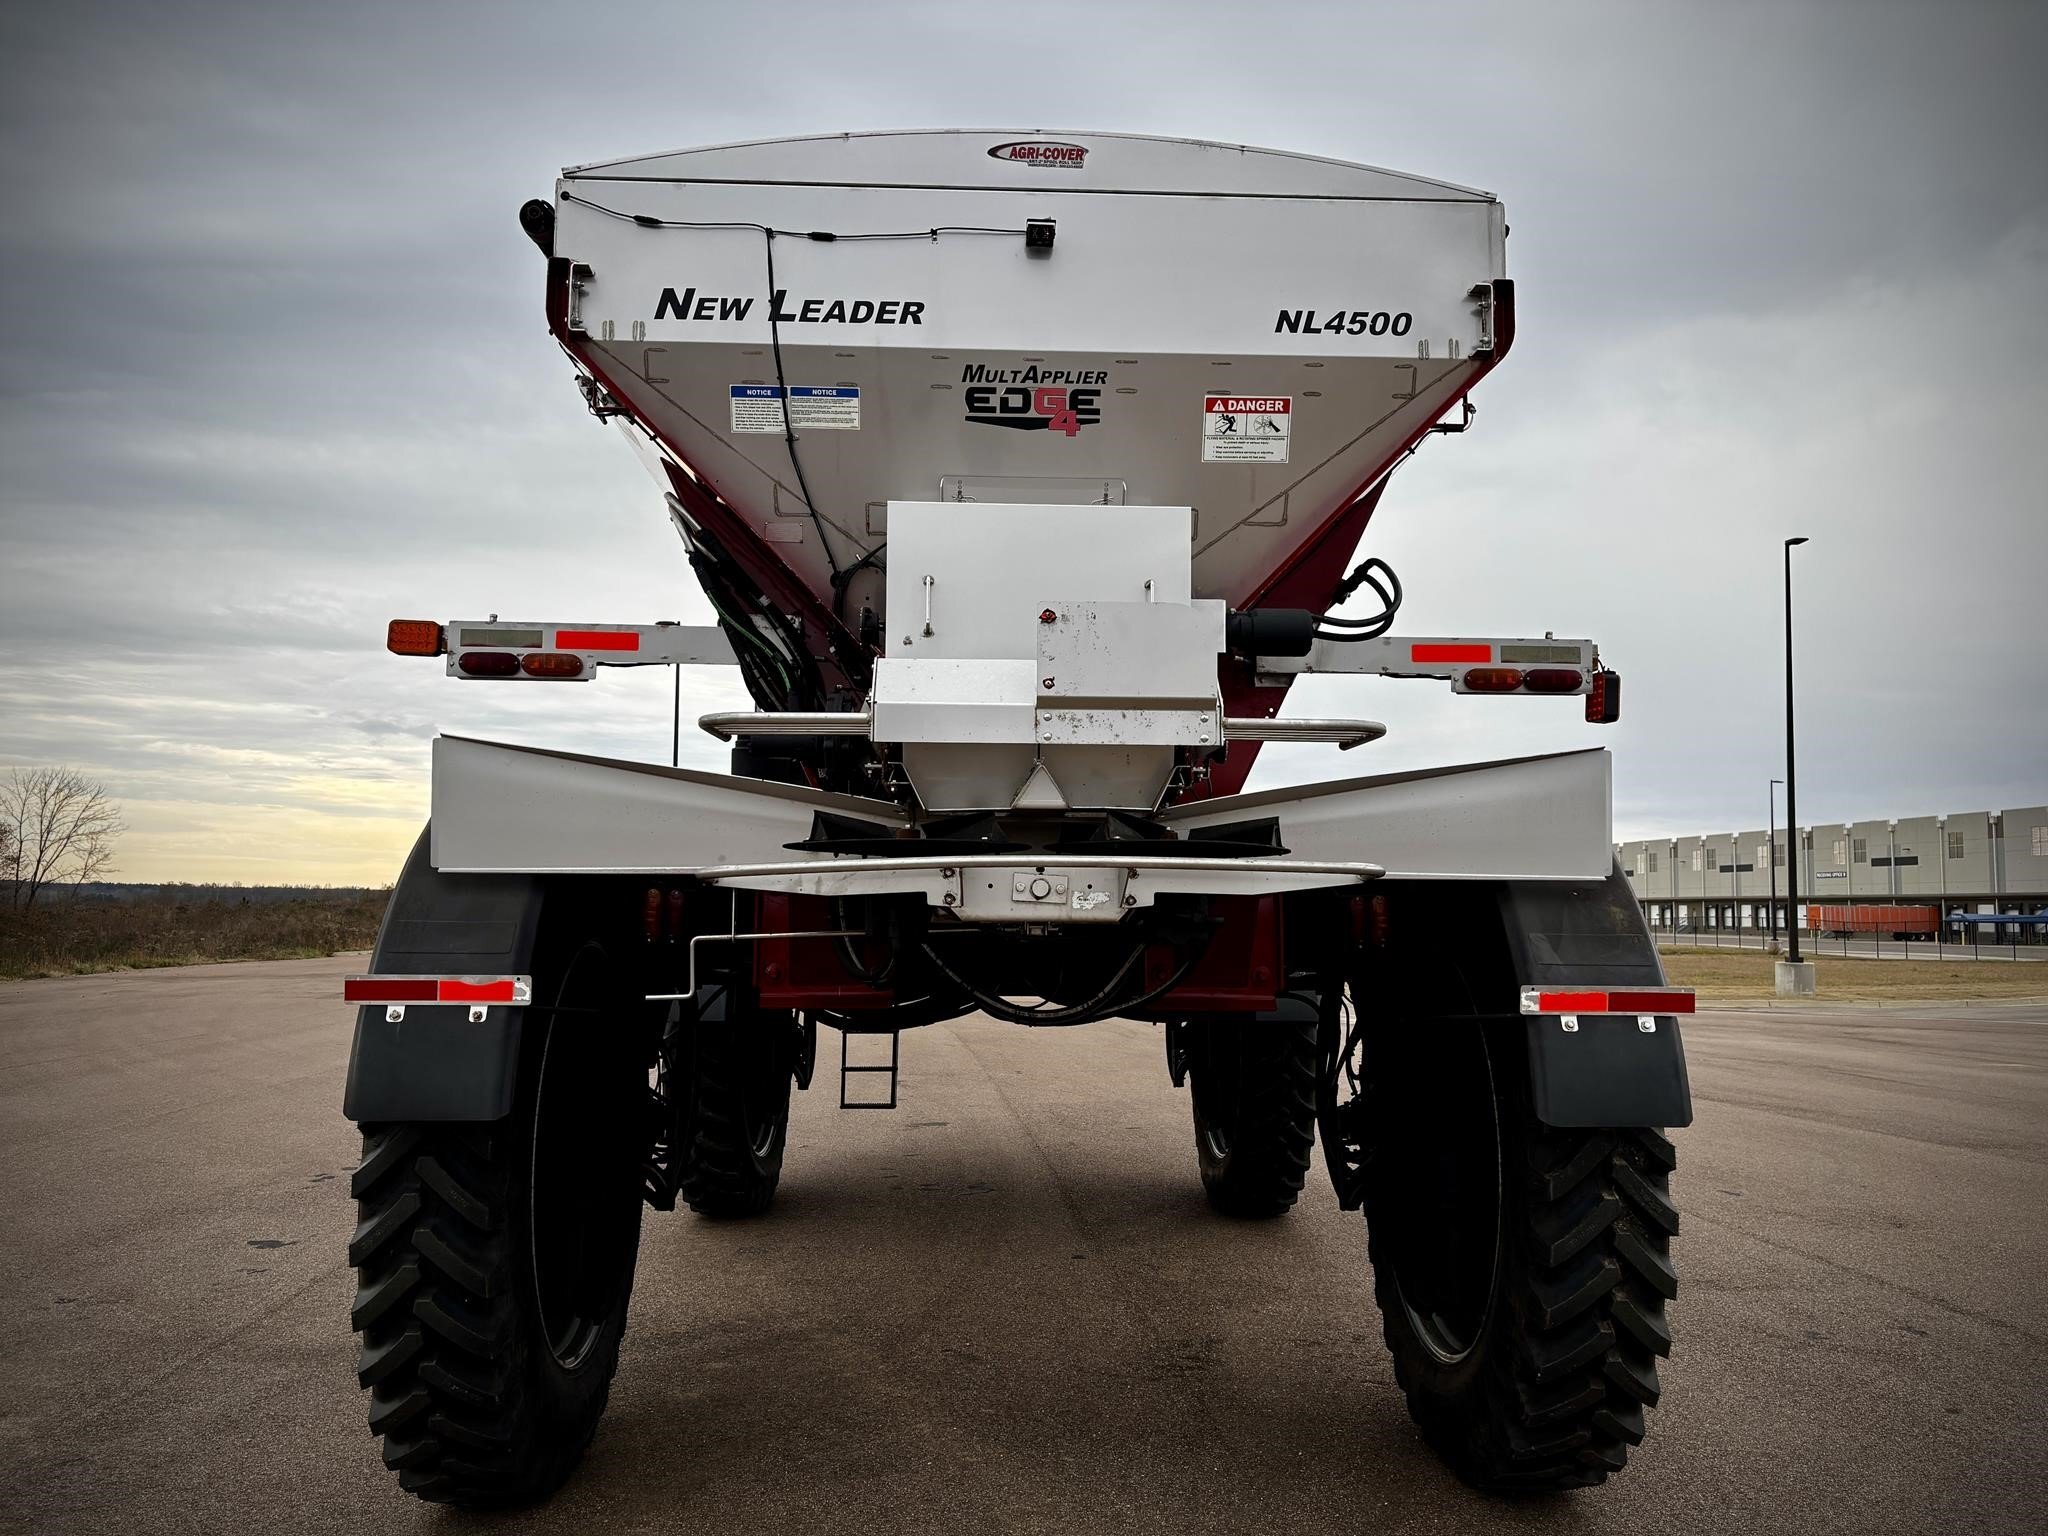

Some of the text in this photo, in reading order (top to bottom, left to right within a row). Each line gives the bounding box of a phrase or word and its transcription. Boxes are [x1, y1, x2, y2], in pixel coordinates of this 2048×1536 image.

[1009, 146, 1085, 161] AGRI-COVER
[1274, 309, 1413, 337] NL4500
[965, 386, 1101, 416] EDGE
[1228, 400, 1284, 412] DANGER
[1048, 409, 1081, 437] 4
